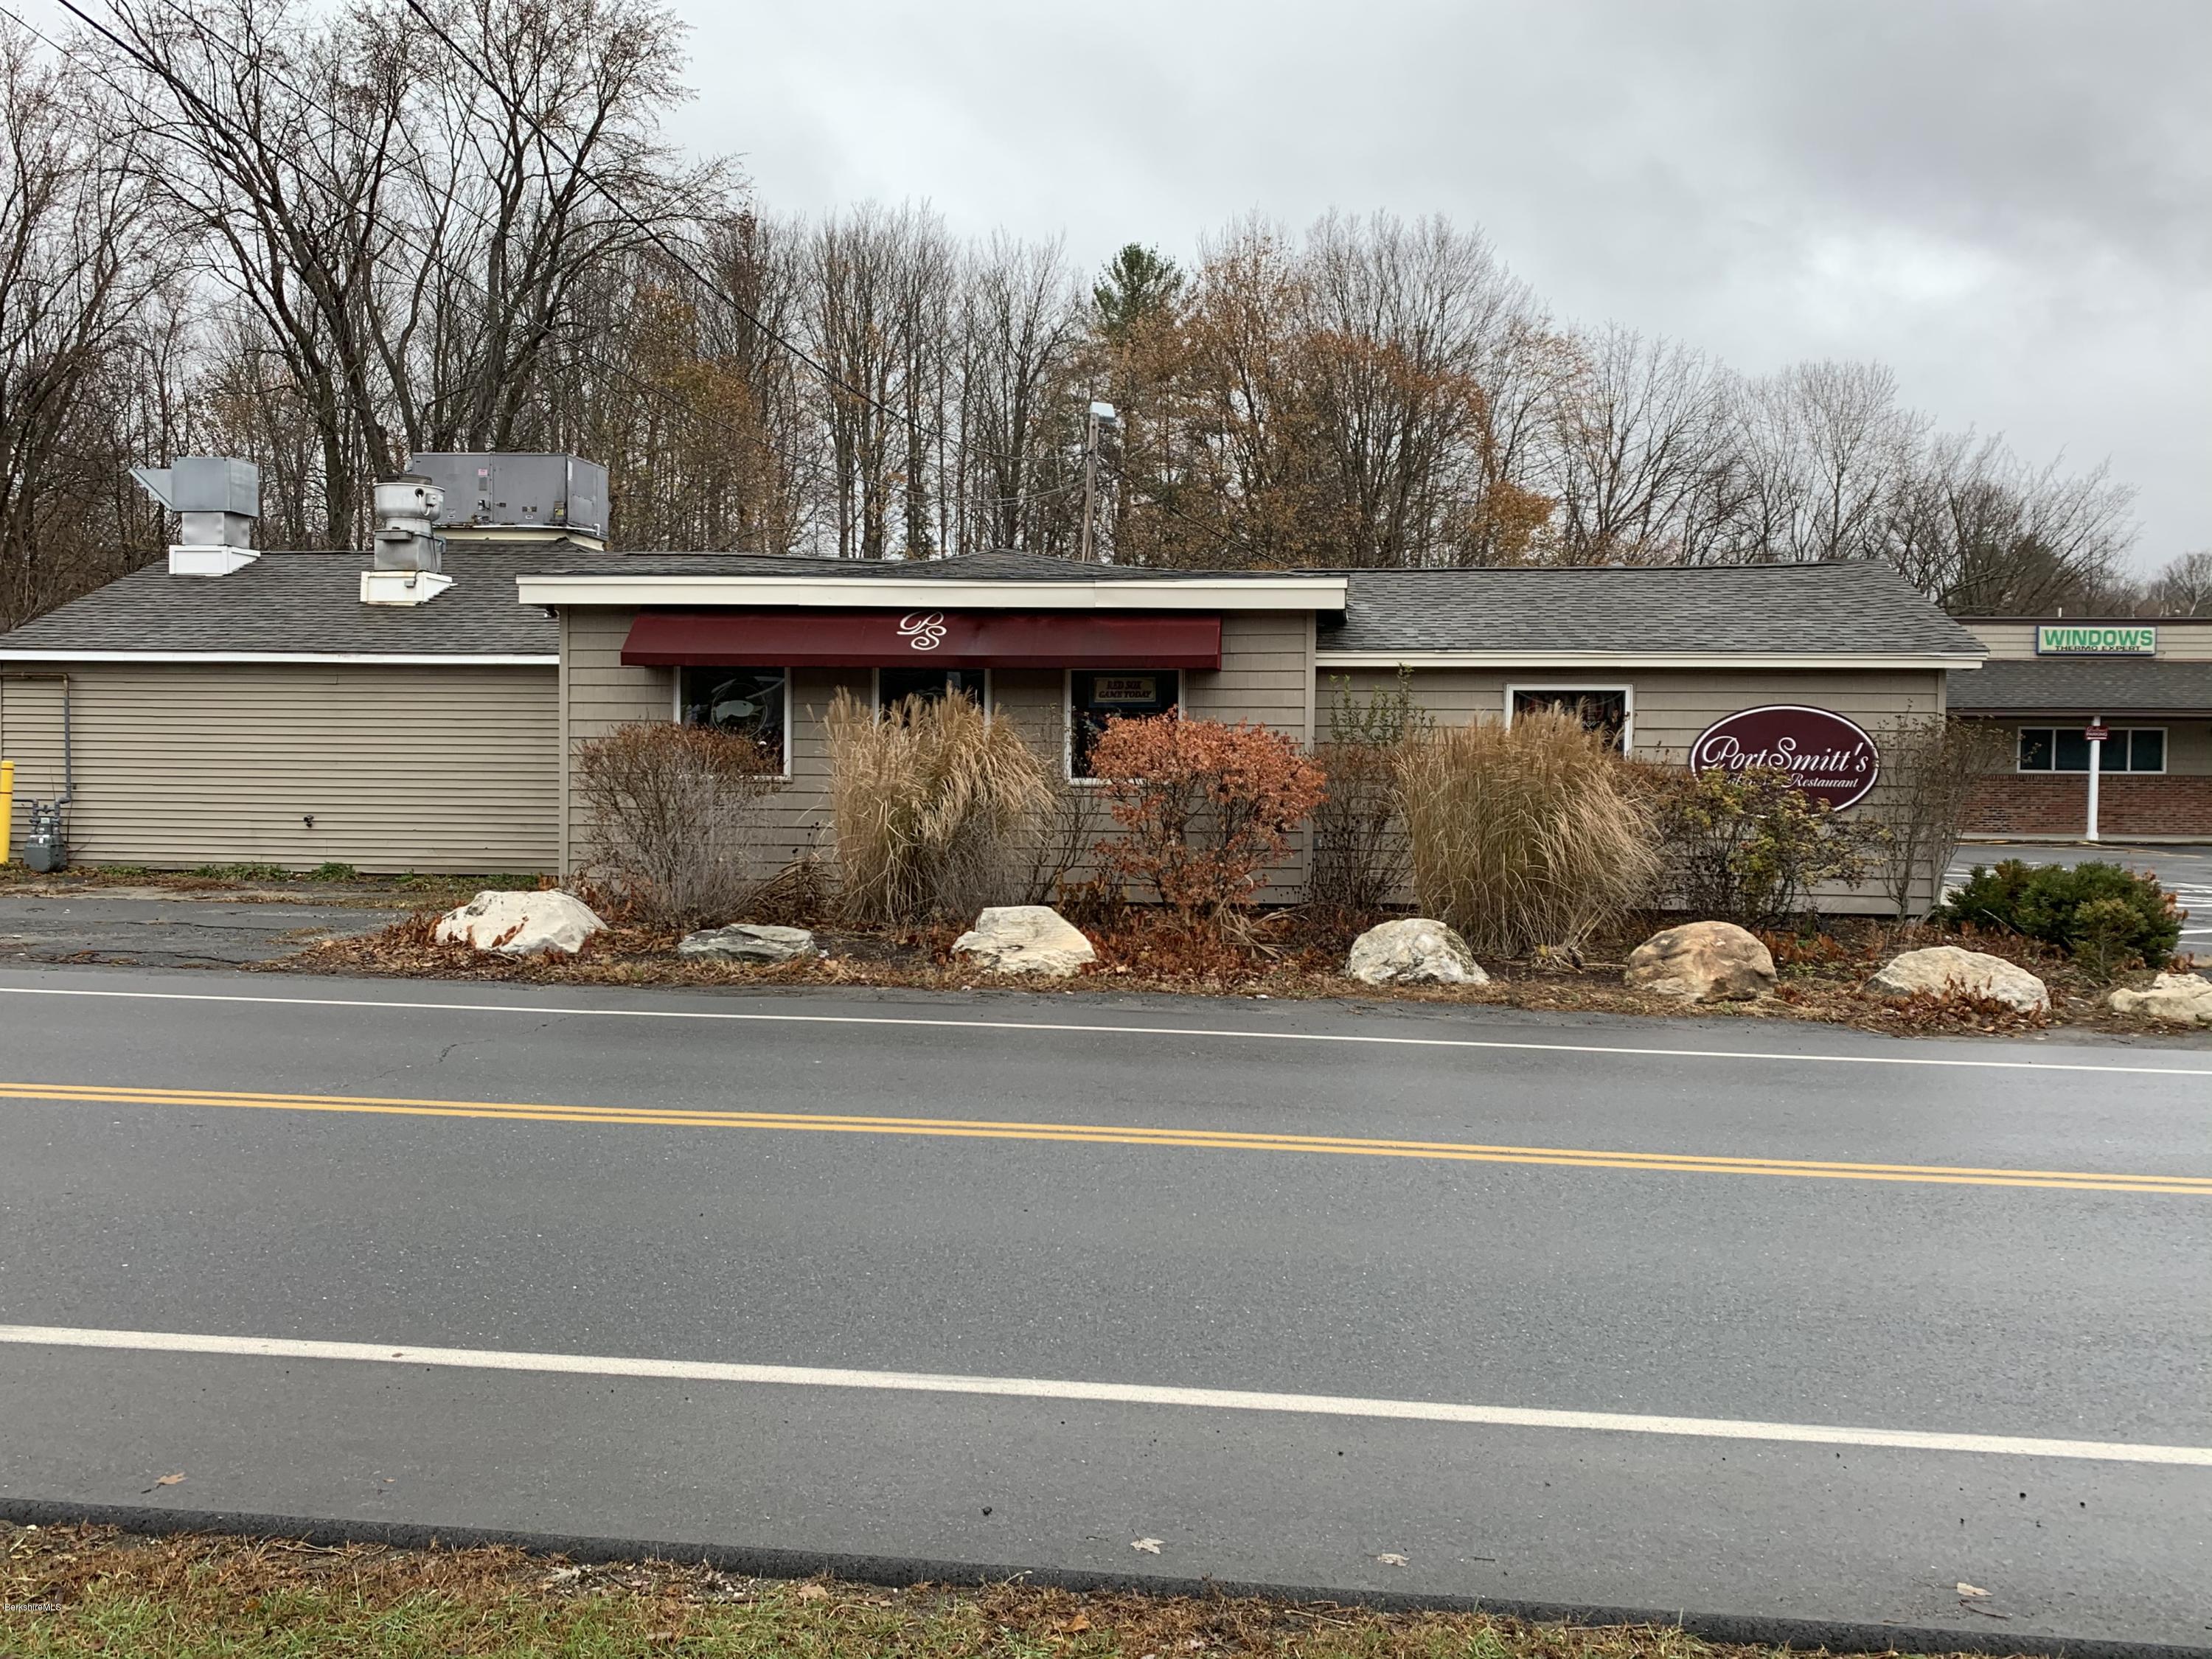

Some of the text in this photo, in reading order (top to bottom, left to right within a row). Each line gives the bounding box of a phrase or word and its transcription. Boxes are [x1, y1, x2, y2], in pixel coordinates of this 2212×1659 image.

[2045, 630, 2153, 645] WINDOWS
[1107, 681, 1124, 689] RED
[1099, 690, 1152, 698] GAME TODAY
[1781, 773, 1859, 789] Restaurant
